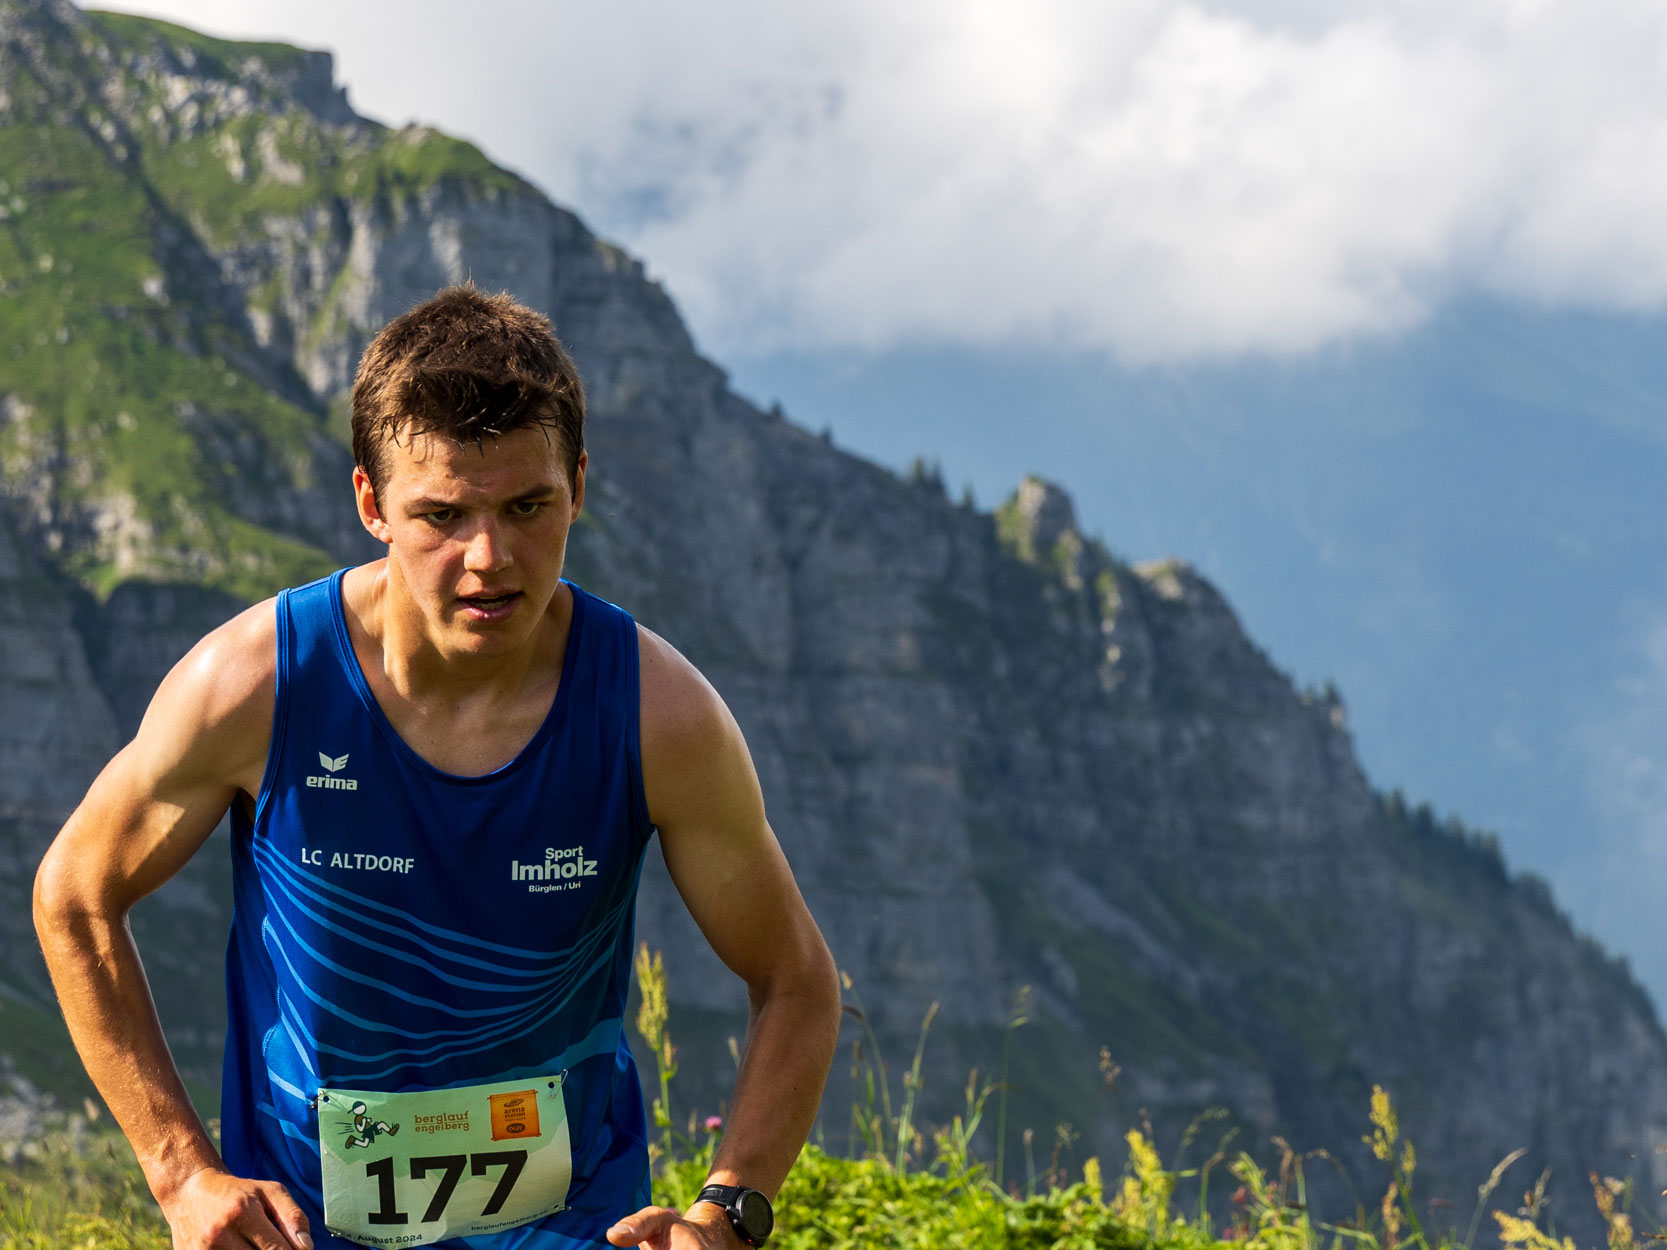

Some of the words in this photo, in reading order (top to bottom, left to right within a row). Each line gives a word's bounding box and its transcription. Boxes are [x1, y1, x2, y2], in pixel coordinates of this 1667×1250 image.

[306, 774, 357, 791] erima
[301, 848, 322, 866] LC
[330, 853, 415, 874] ALTDORF
[545, 845, 584, 862] Sport
[511, 857, 598, 881] Imholz
[528, 883, 562, 894] Bürglen
[568, 881, 582, 890] Uri
[414, 1110, 470, 1124] berglauf
[504, 1106, 526, 1114] arena
[414, 1121, 470, 1134] engelberg
[366, 1149, 528, 1225] 177
[357, 1234, 394, 1244] August
[395, 1233, 423, 1244] 2024
